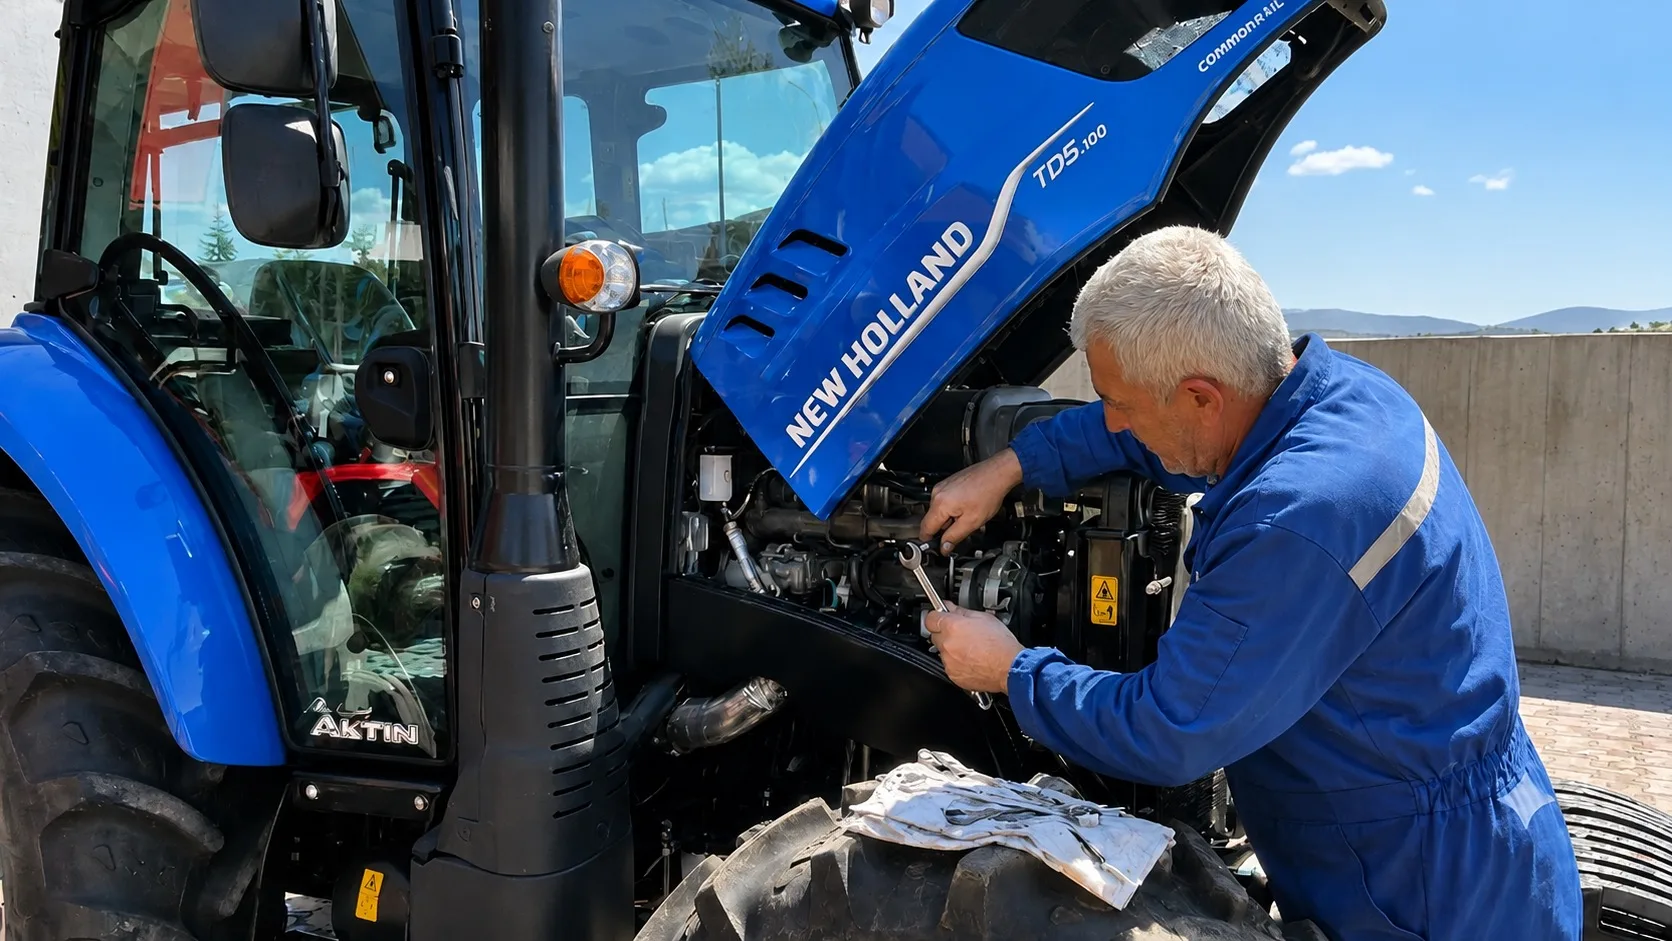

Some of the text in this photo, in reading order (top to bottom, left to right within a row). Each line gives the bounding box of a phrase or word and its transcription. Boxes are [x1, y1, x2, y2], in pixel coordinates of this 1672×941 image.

[1032, 124, 1107, 188] TD5.100
[785, 221, 974, 448] NEW HOLLAND
